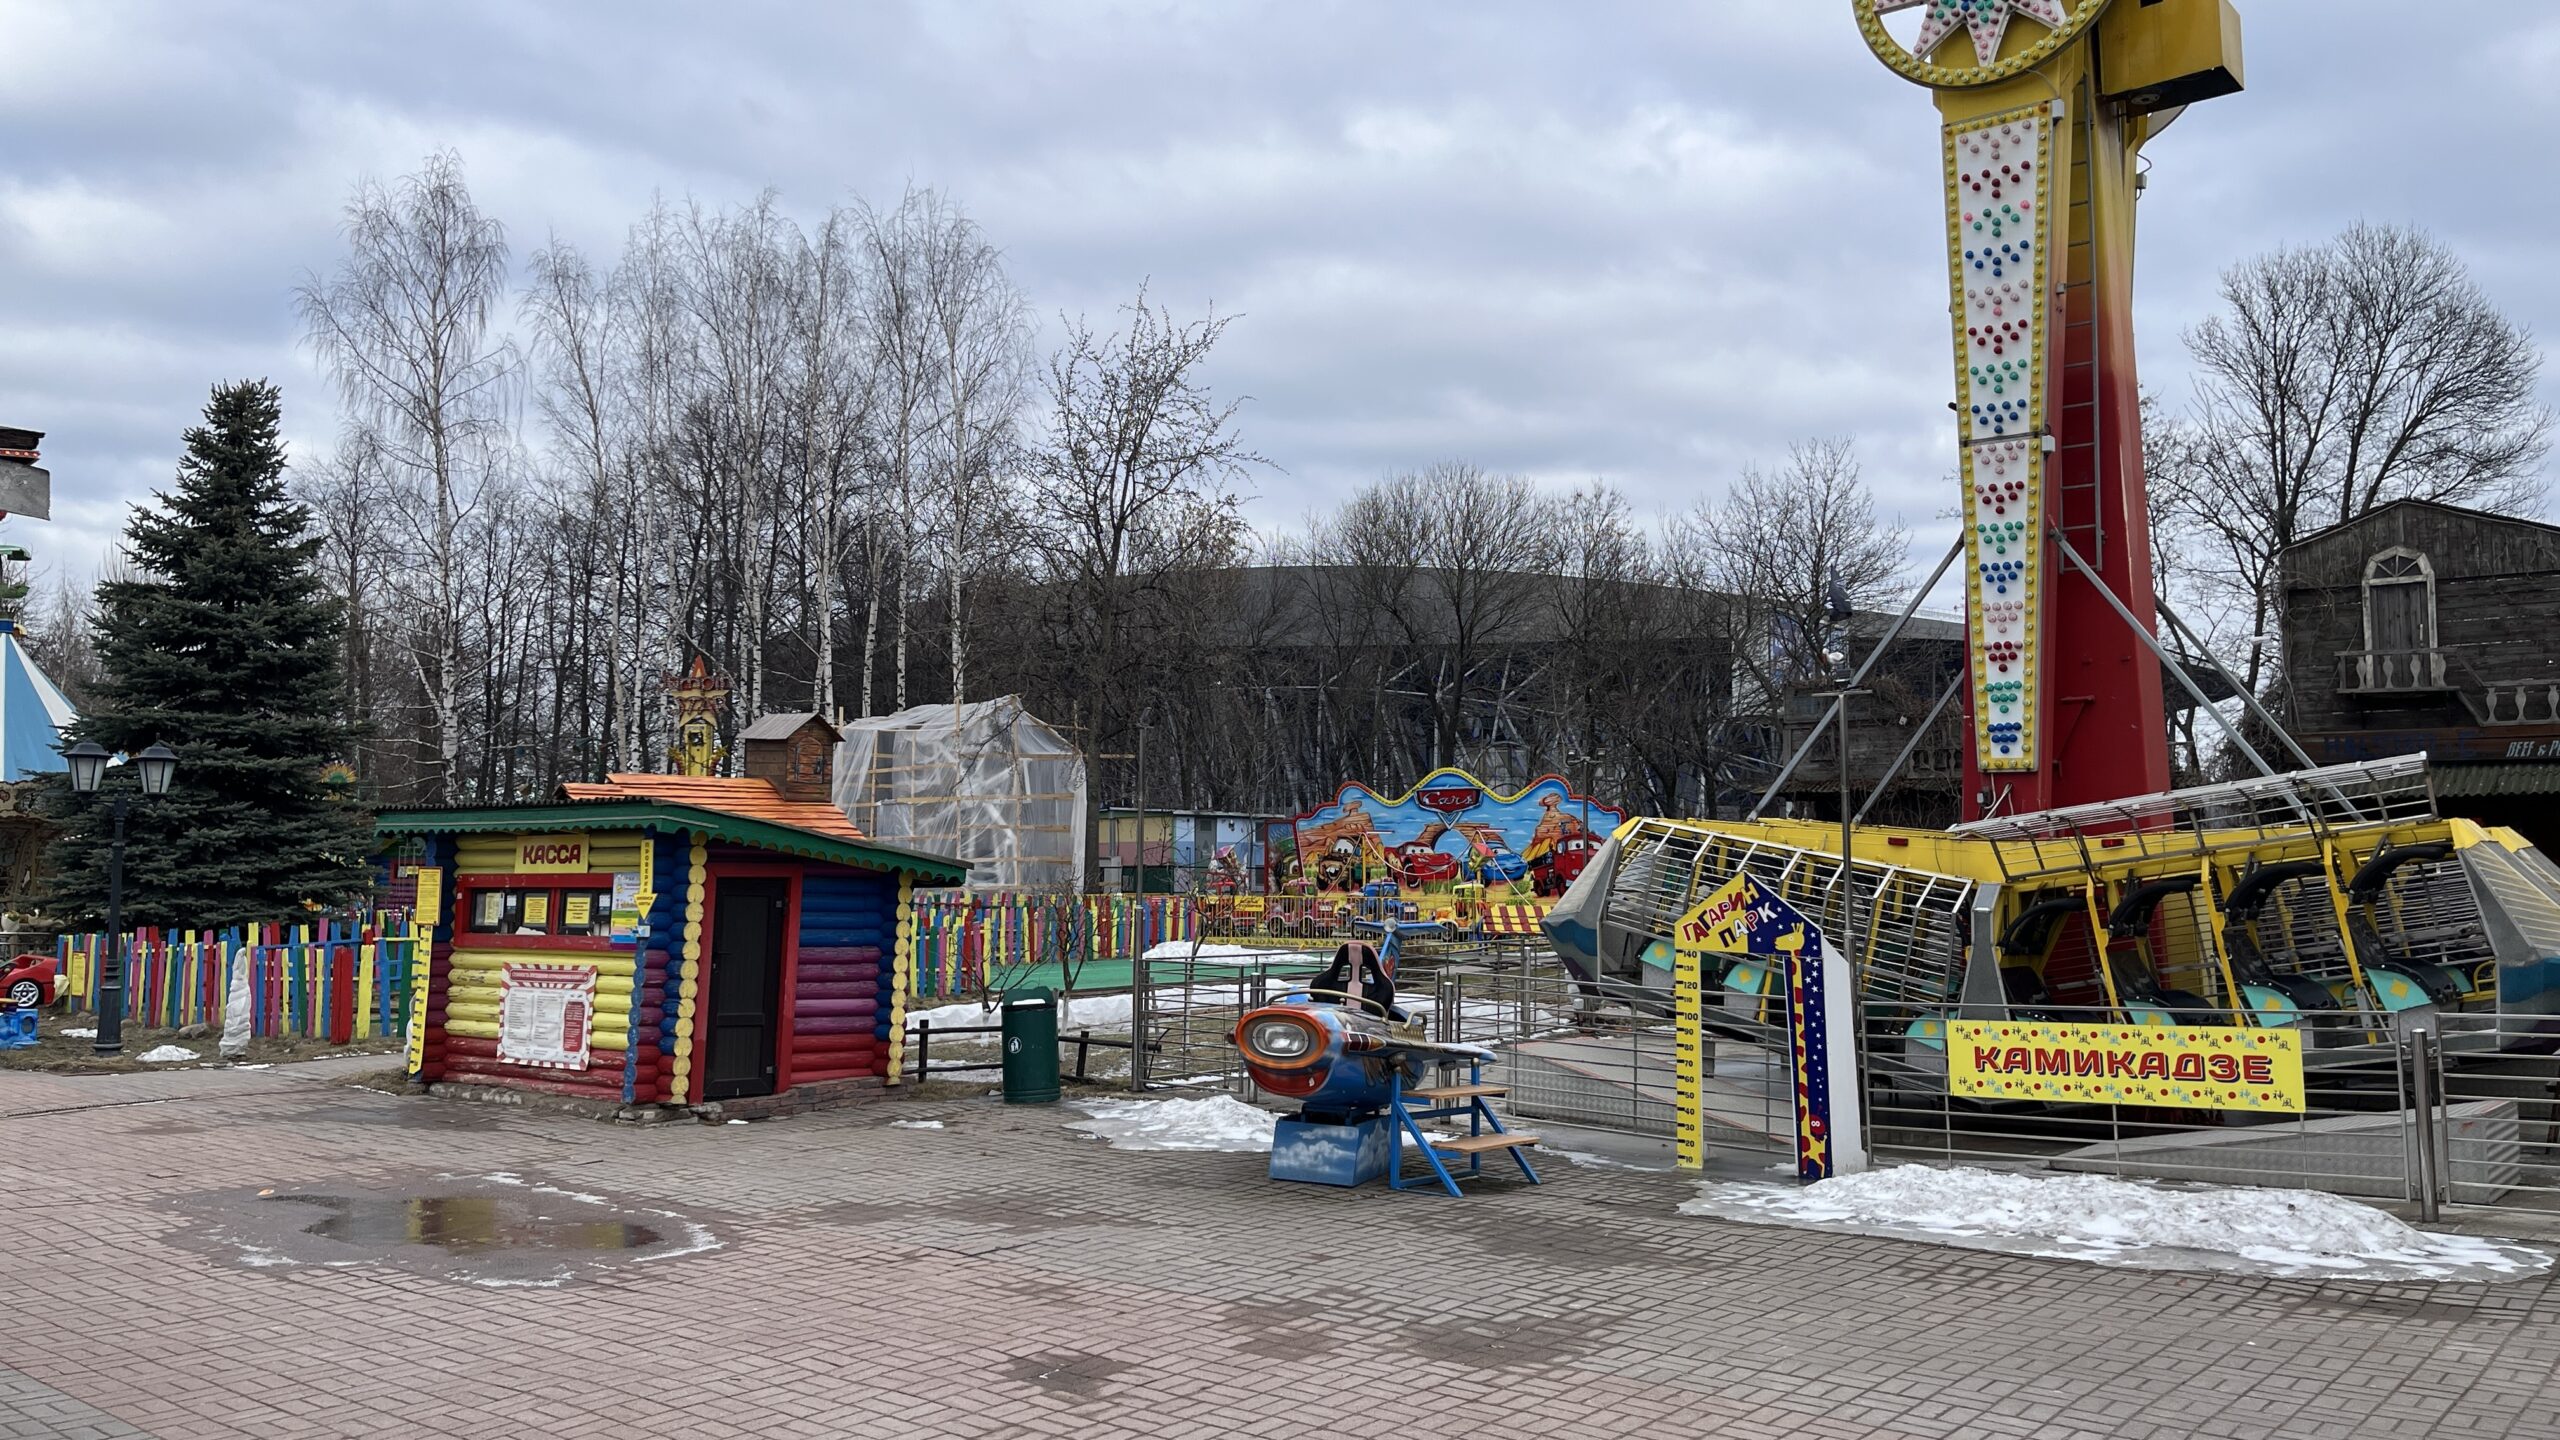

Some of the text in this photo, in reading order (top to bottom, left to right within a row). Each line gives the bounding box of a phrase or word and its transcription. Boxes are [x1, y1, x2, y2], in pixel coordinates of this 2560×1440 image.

[2506, 741, 2535, 757] BEEF
[523, 844, 581, 864] КАССА
[1682, 882, 1760, 943] ГАГАРИН
[1718, 901, 1778, 948] ПАРК
[1683, 950, 1697, 958] 140
[1974, 1046, 2273, 1084] КАМИКАДЗЕ
